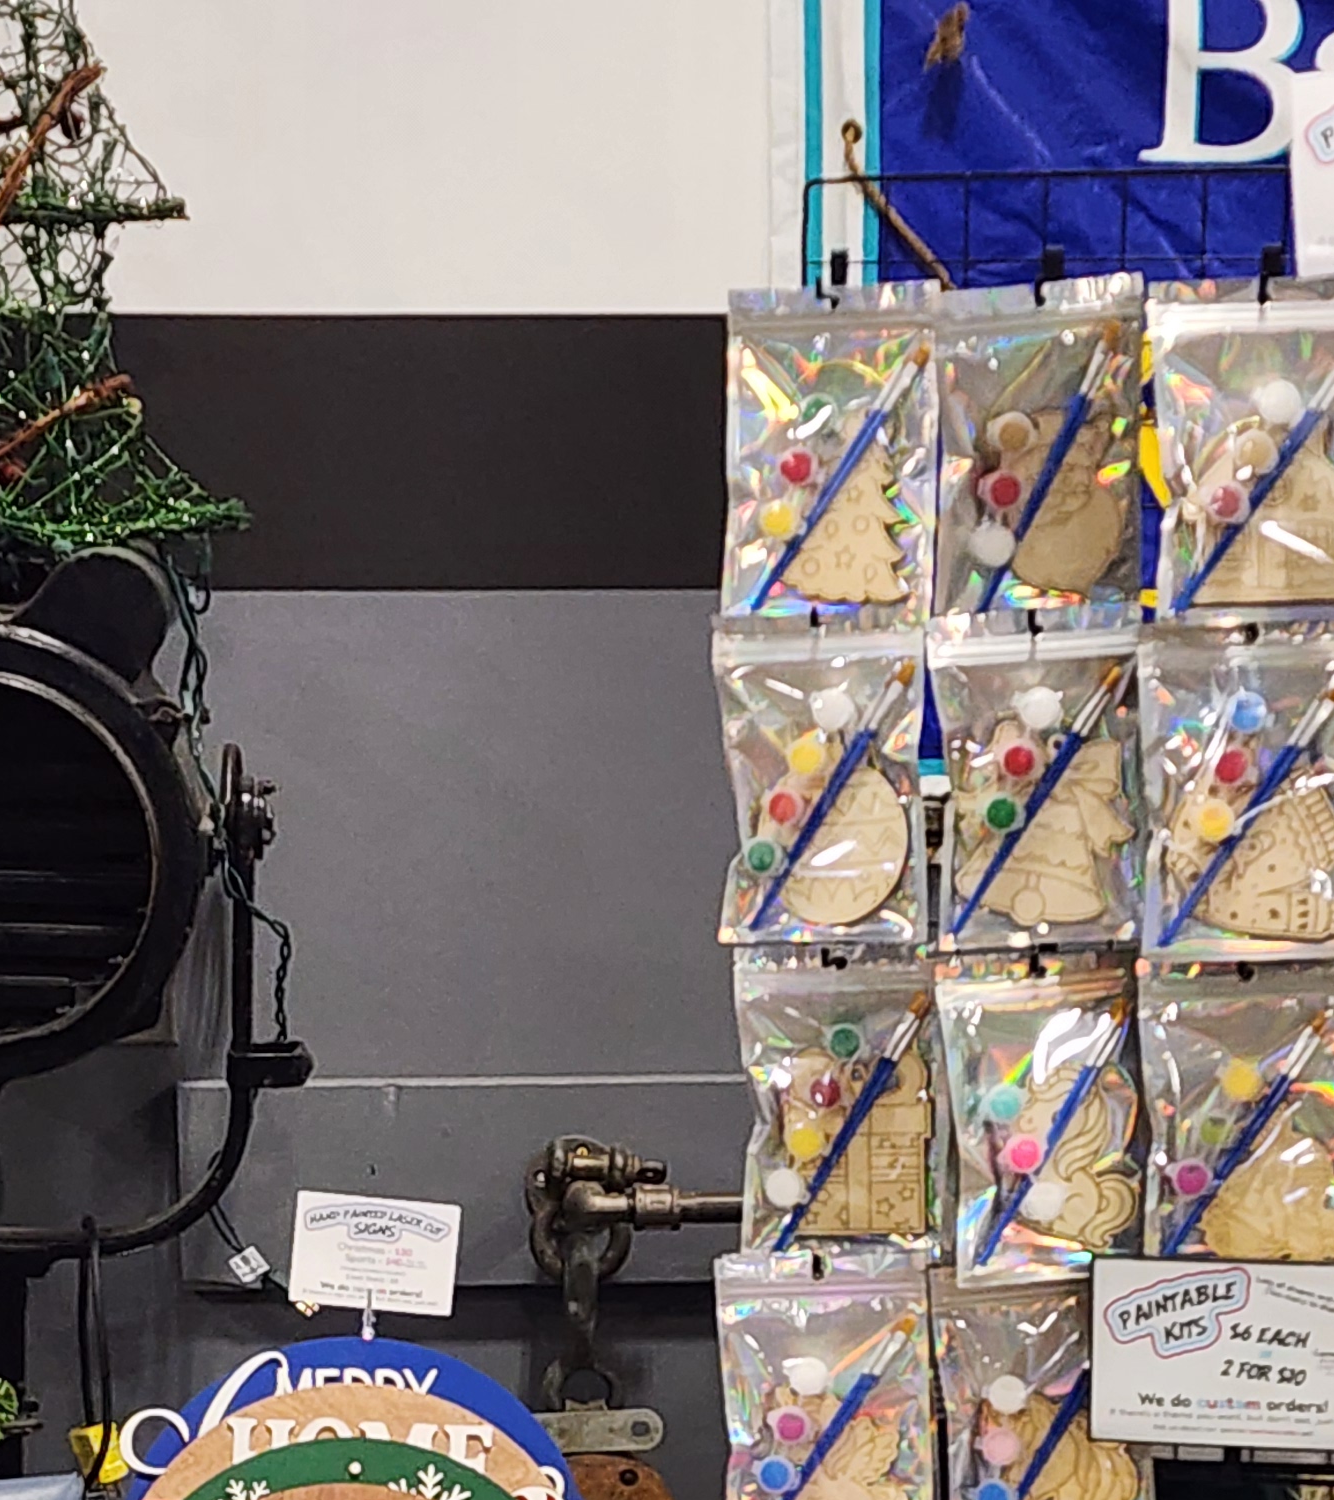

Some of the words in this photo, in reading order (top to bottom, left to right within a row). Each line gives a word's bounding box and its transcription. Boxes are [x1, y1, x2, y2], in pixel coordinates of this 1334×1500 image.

[354, 1221, 397, 1238] SIGNS
[1117, 1280, 1238, 1331] PAINTABLE
[1164, 1316, 1208, 1345] KITS
[1256, 1326, 1312, 1348] EACH
[1220, 1359, 1234, 1377] 2
[1236, 1360, 1273, 1382] FOR
[1138, 1392, 1166, 1408] We
[1170, 1392, 1193, 1409] do
[1266, 1399, 1329, 1414] orders!
